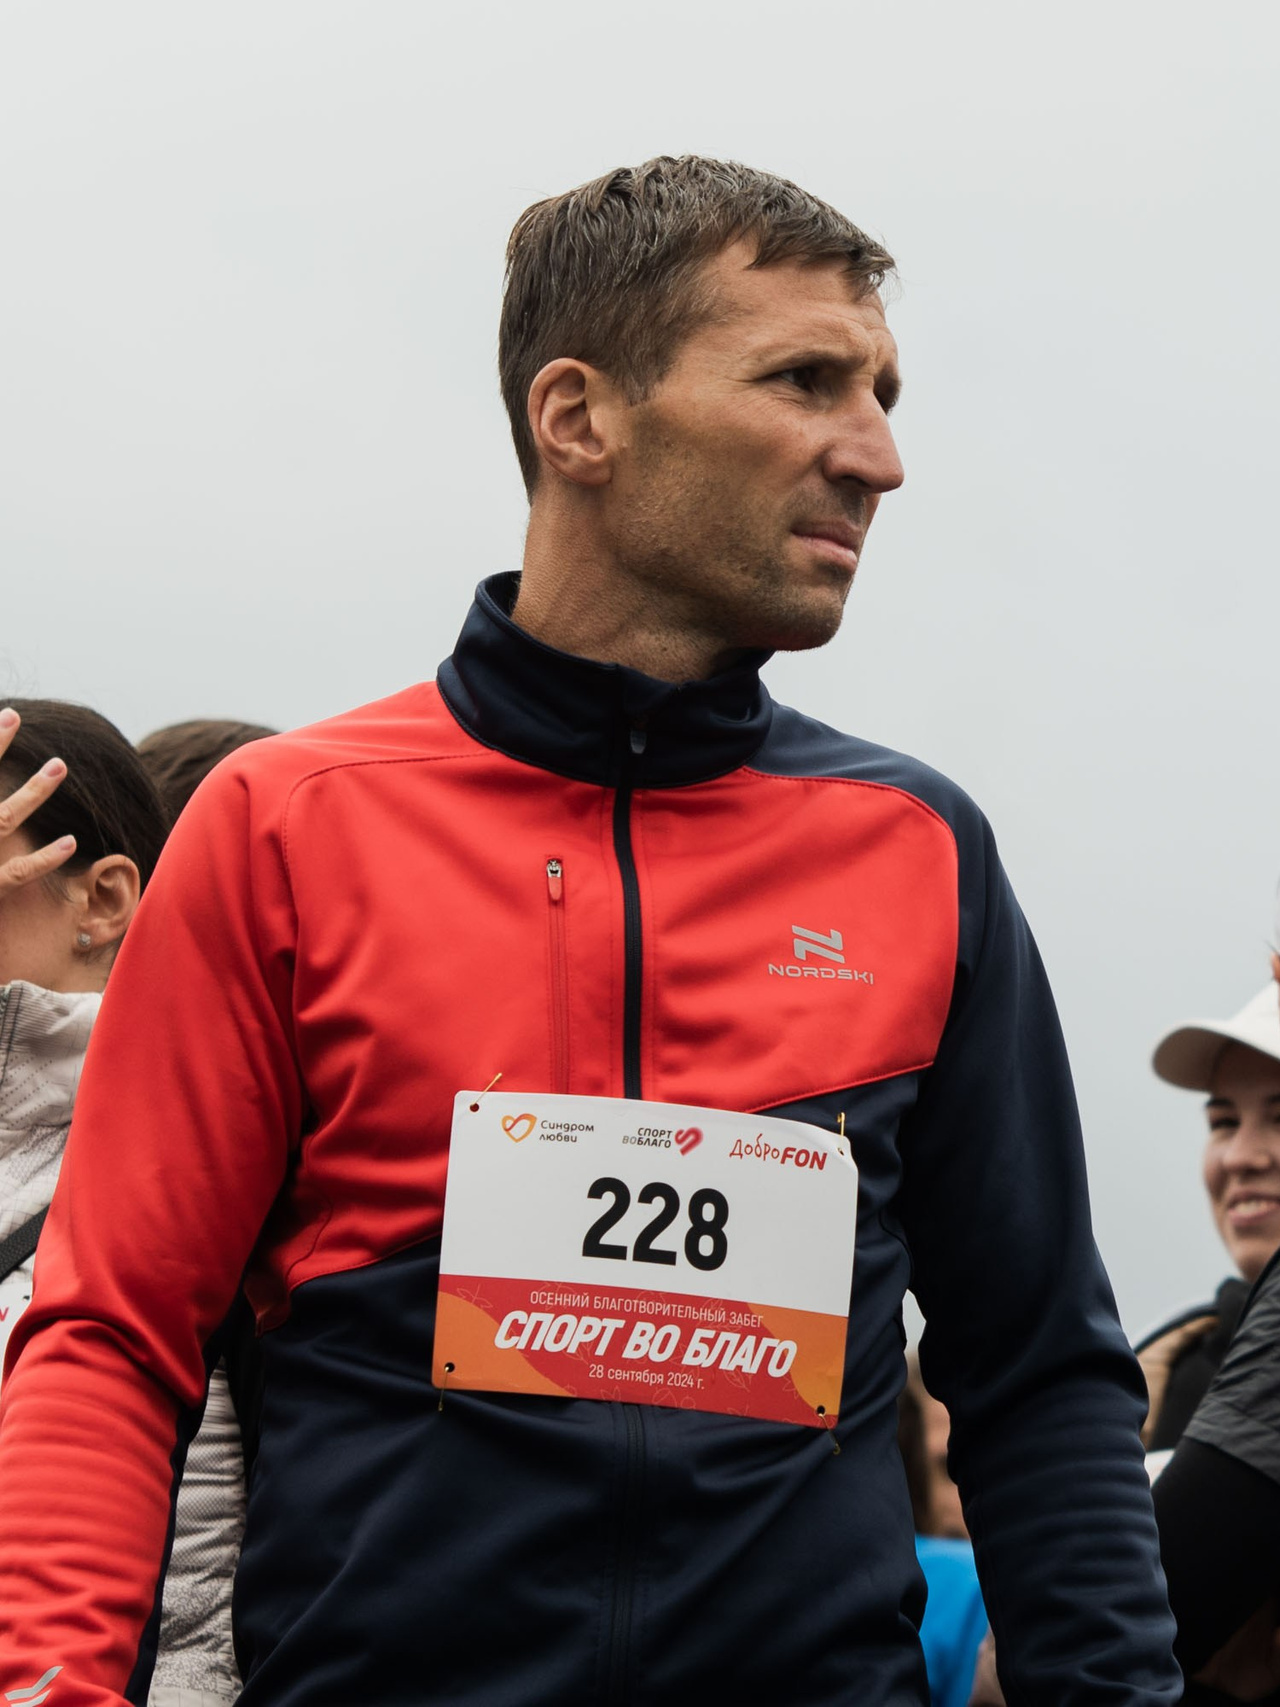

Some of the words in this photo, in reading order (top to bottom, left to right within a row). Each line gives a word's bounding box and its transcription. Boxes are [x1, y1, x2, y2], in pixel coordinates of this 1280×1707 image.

[768, 963, 874, 985] NORDSKI
[540, 1120, 594, 1132] Синдром
[637, 1127, 673, 1139] СПОРТ
[539, 1133, 577, 1143] любви
[581, 1176, 729, 1271] 228
[530, 1291, 589, 1308] ОСЕННИЙ
[593, 1296, 726, 1323] БЛАГОТВОРИТЕЛЬНЫЙ
[729, 1311, 763, 1328] ЗАБЕГ
[494, 1310, 626, 1356] СПОРТ
[622, 1321, 681, 1363] ВО
[681, 1328, 798, 1378] БЛАГО
[588, 1364, 604, 1378] 28
[607, 1368, 664, 1386] сентября
[667, 1372, 694, 1388] 2024
[697, 1378, 705, 1389] г.
